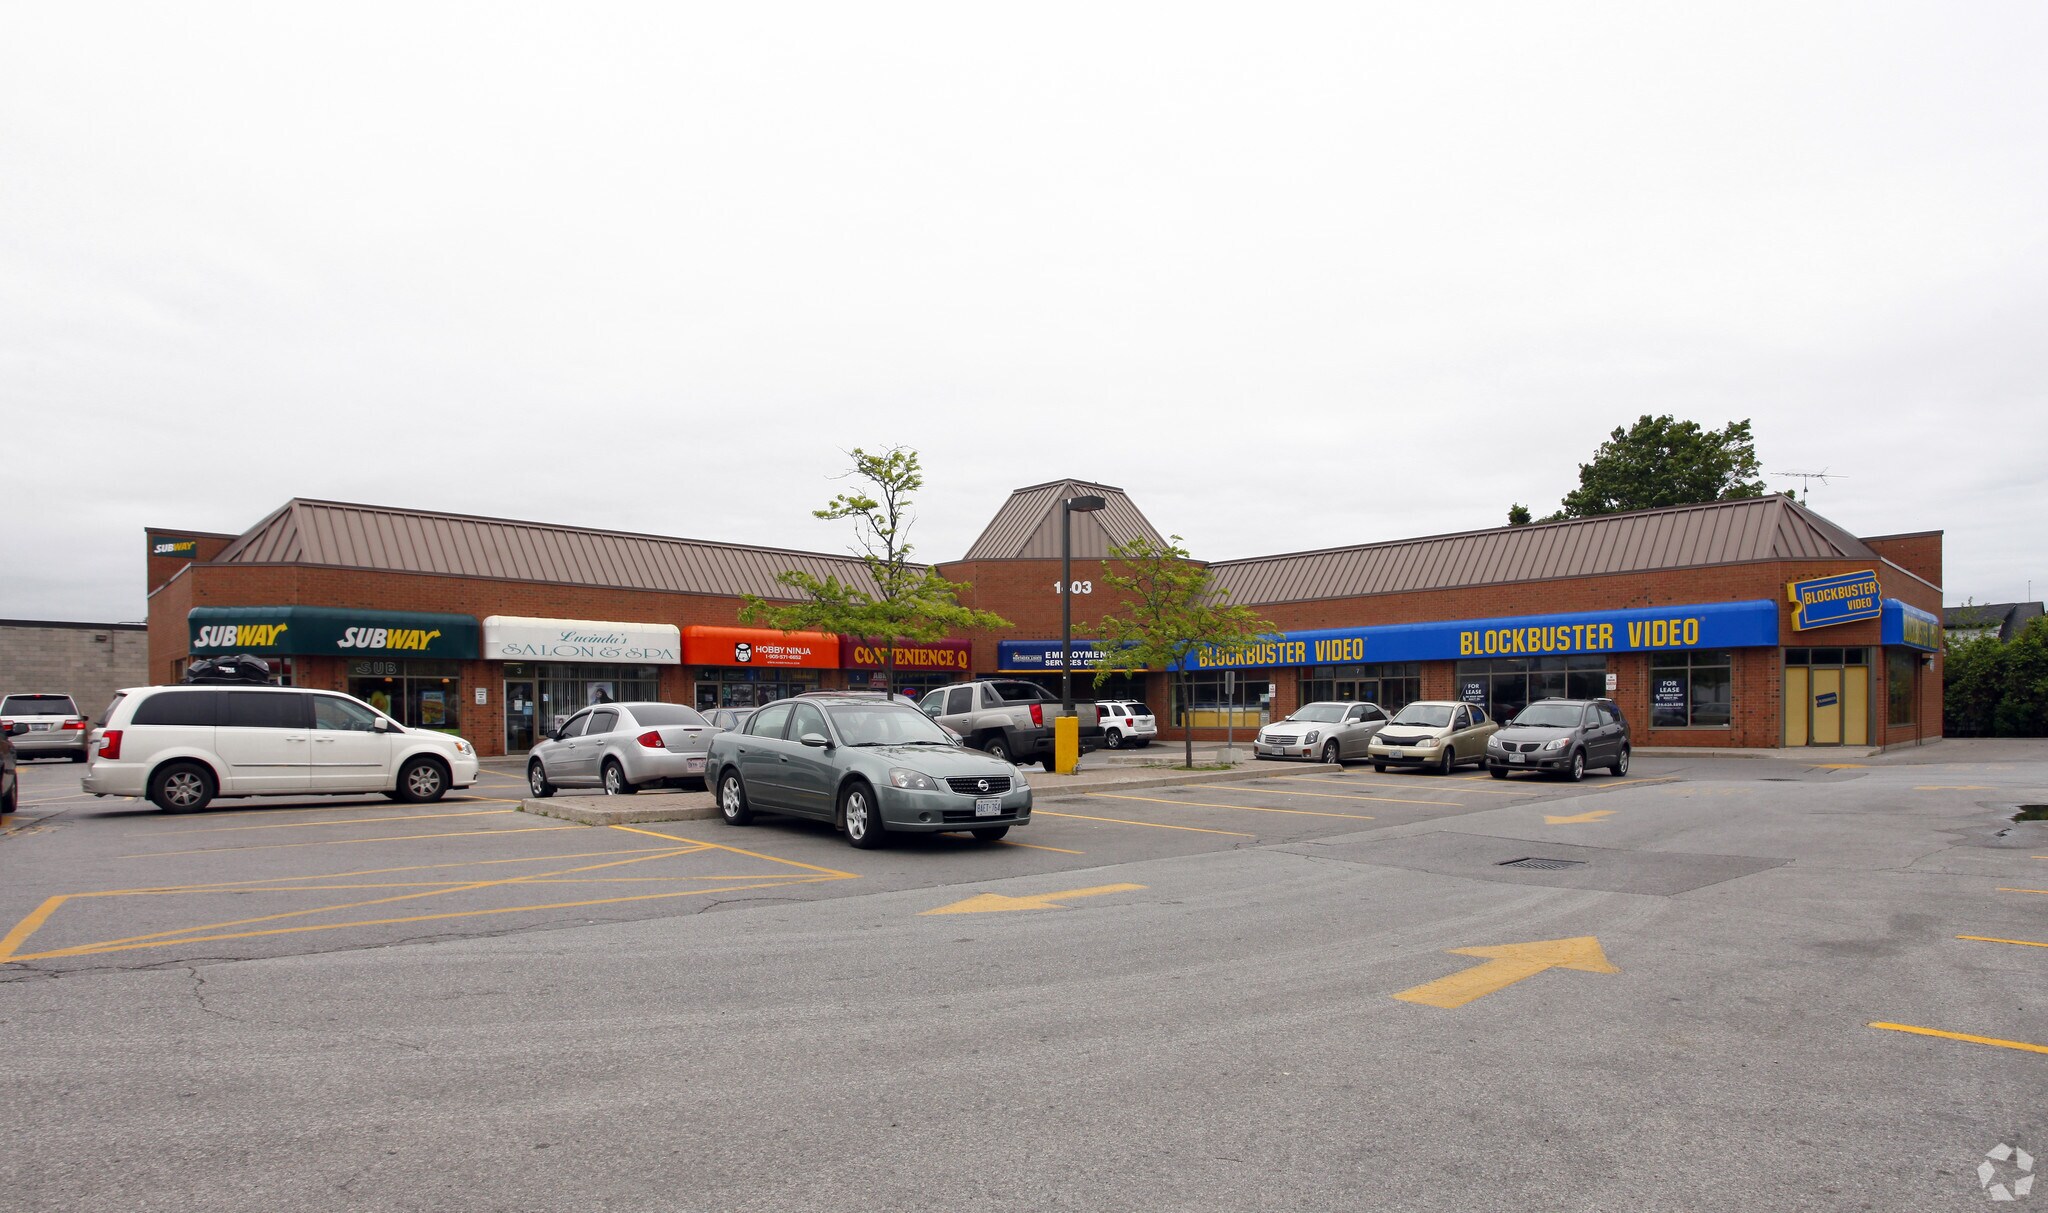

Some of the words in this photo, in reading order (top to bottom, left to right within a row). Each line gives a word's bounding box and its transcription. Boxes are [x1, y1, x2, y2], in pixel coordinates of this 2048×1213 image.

[154, 542, 196, 553] SUBWAY
[1054, 580, 1092, 594] 103
[1804, 581, 1877, 605] BLOCKBUSTER
[1847, 597, 1872, 610] VIDEO
[193, 623, 288, 648] SUBWAY
[336, 627, 441, 650] SUBWAY
[556, 631, 627, 645] Lucinda's
[1460, 622, 1613, 655] BLOCKBUSTER
[1628, 618, 1699, 648] VIDEO
[502, 643, 594, 658] SALON
[599, 647, 622, 658] &
[625, 648, 674, 660] SPA
[755, 645, 785, 654] HOBBY
[786, 647, 811, 655] NINJA
[1045, 651, 1112, 659] EMOYMEN
[1199, 641, 1306, 668] BLOCKBUSTER
[1315, 637, 1364, 662] VIDEO
[957, 650, 968, 669] Q
[1045, 659, 1082, 667] SERES
[356, 662, 397, 675] SUB
[516, 667, 522, 675] 3
